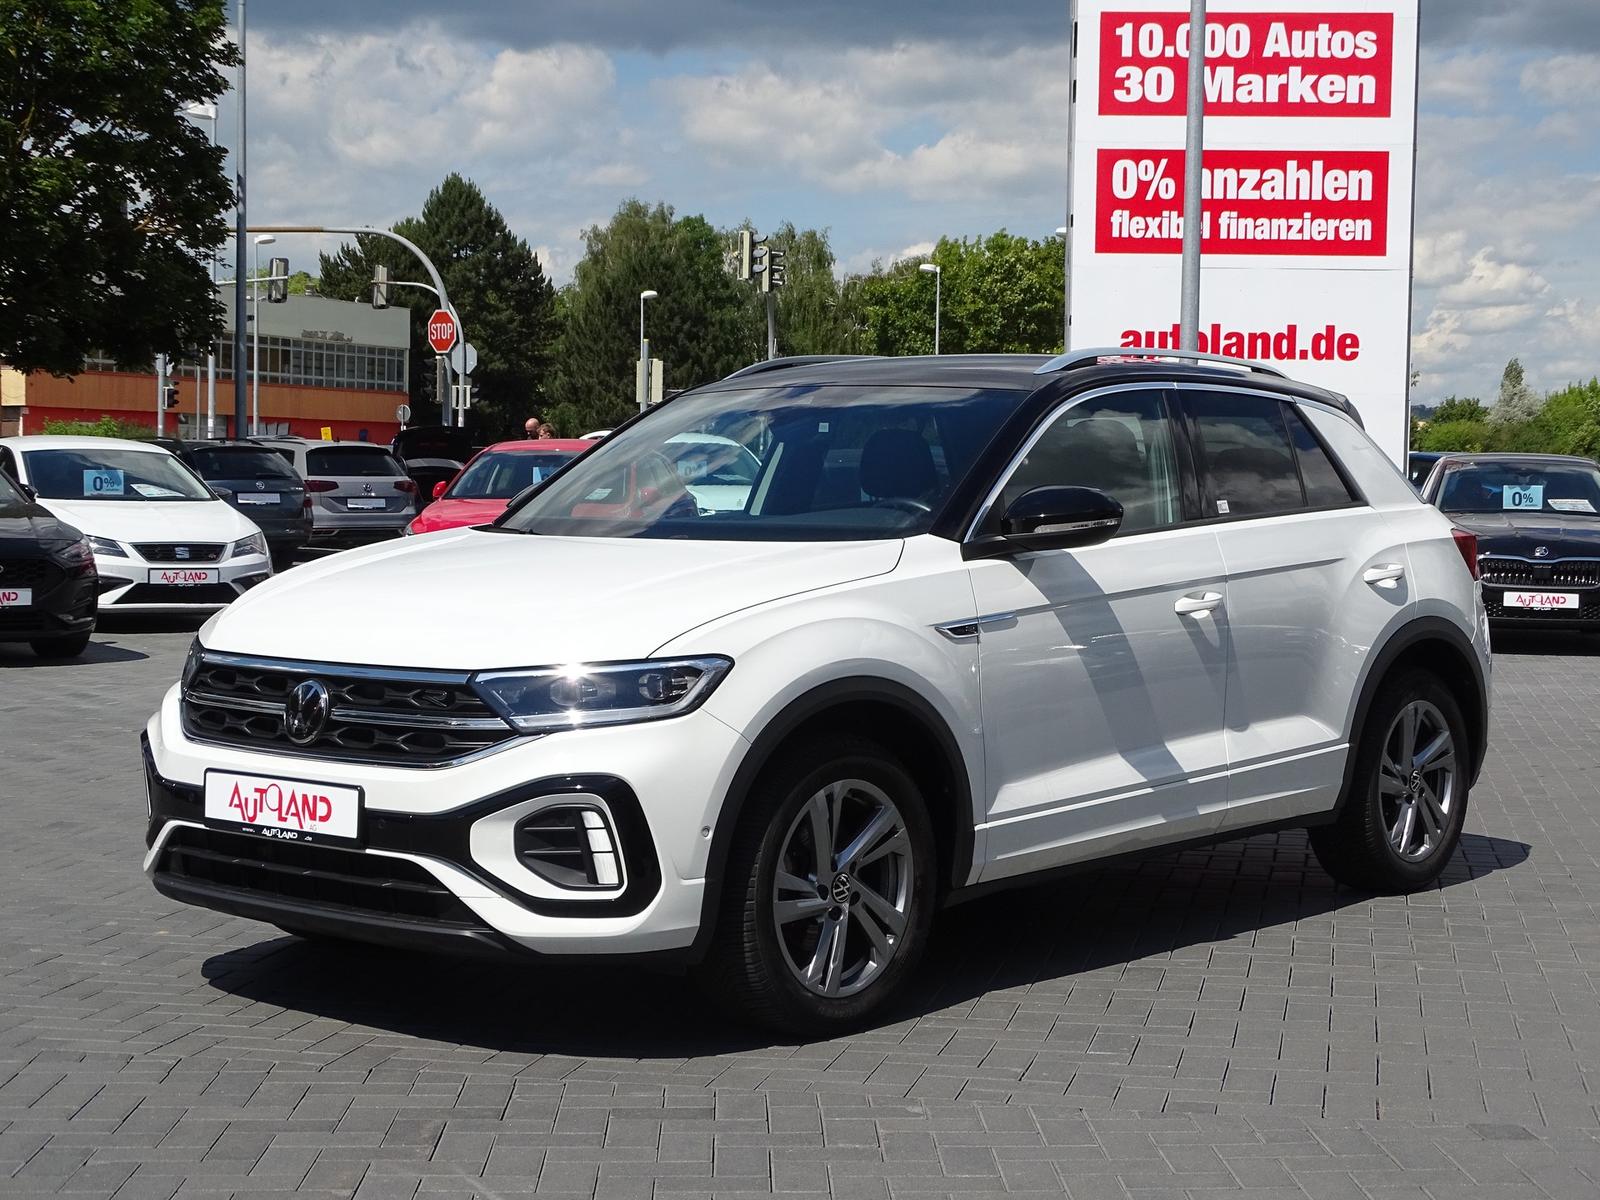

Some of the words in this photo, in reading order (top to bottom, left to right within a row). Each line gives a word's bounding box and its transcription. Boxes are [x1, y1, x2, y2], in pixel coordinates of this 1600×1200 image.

[1262, 22, 1377, 58] Autos
[1113, 66, 1175, 102] 30
[1203, 66, 1376, 103] Marken
[1112, 158, 1176, 200] 0%
[1110, 209, 1211, 239] flexibl
[1218, 211, 1372, 241] finanzieren
[431, 323, 453, 340] STOP
[93, 476, 115, 491] 0%
[1512, 491, 1534, 507] 0%
[229, 781, 332, 829] AUTOLAND
